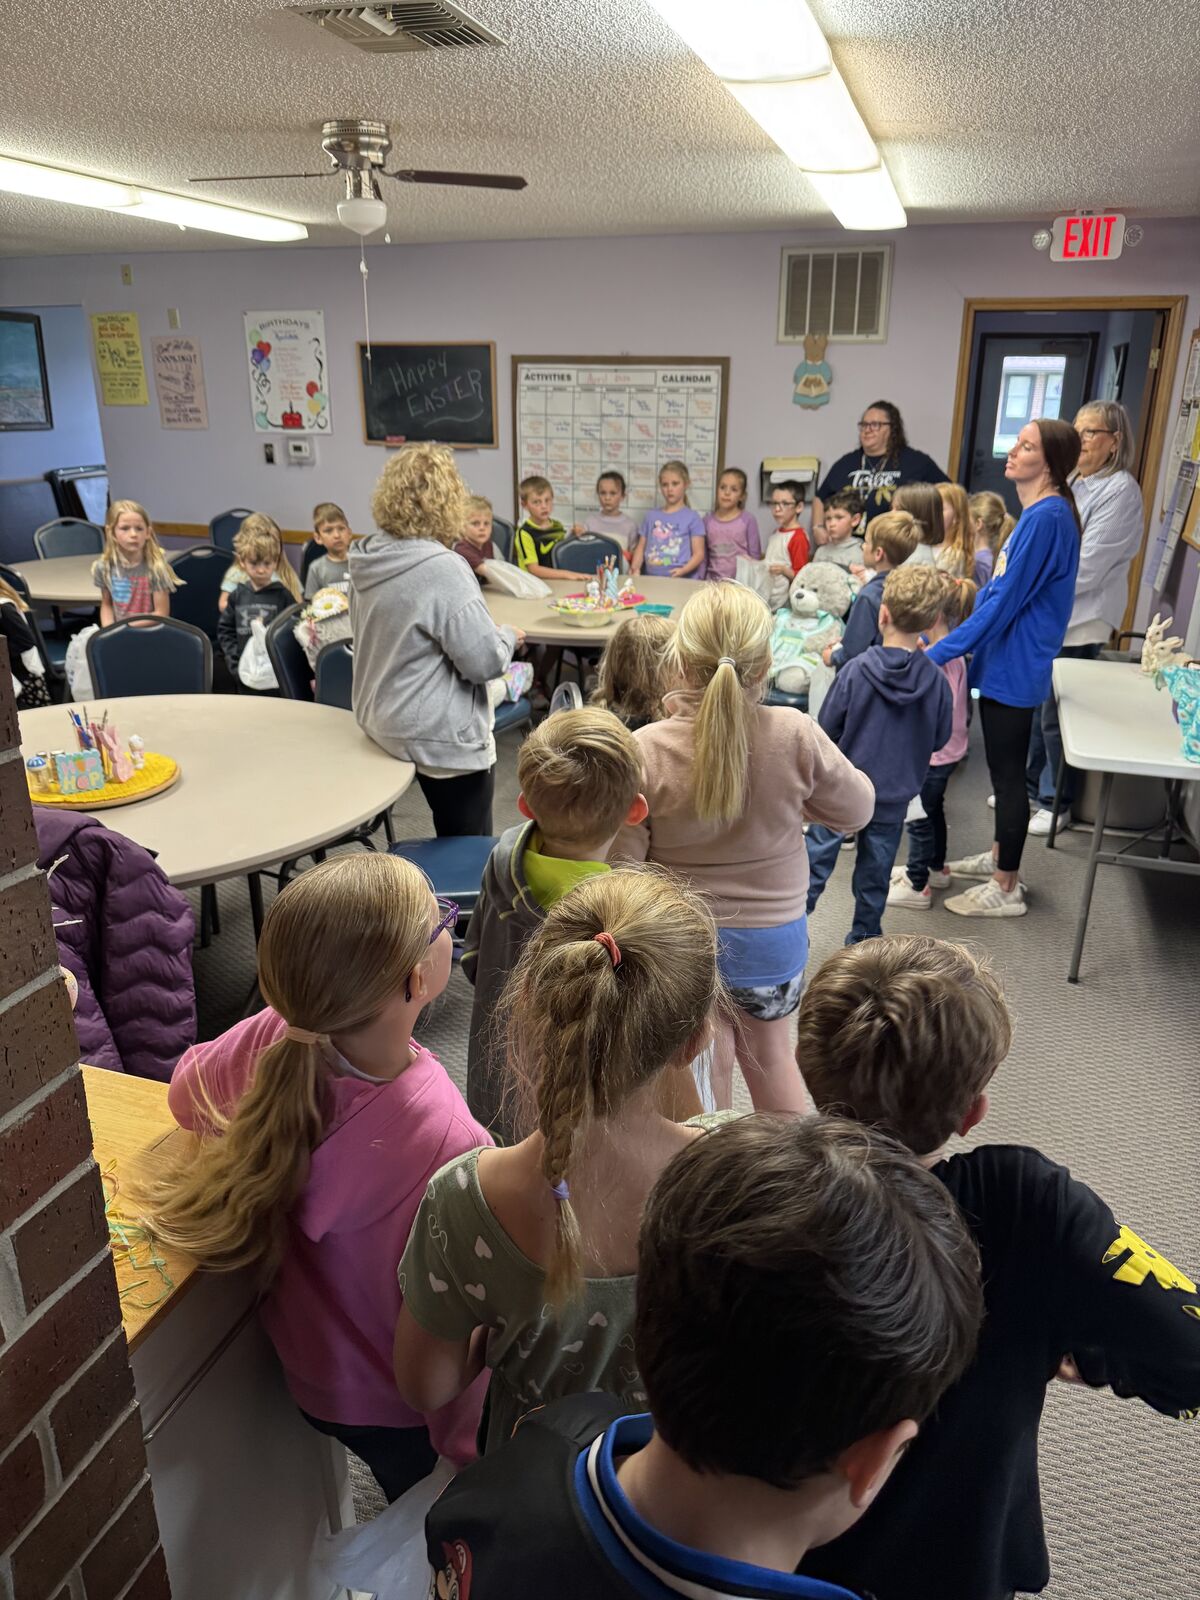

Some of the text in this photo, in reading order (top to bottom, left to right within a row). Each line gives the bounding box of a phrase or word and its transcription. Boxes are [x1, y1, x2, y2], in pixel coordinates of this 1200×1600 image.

[1062, 216, 1117, 258] EXIT
[259, 318, 310, 330] BIRTHDAYS
[388, 351, 448, 396] HAPPY
[524, 373, 572, 382] ACTIVITIES
[661, 374, 712, 384] CALENDAR
[406, 368, 484, 417] EASTER
